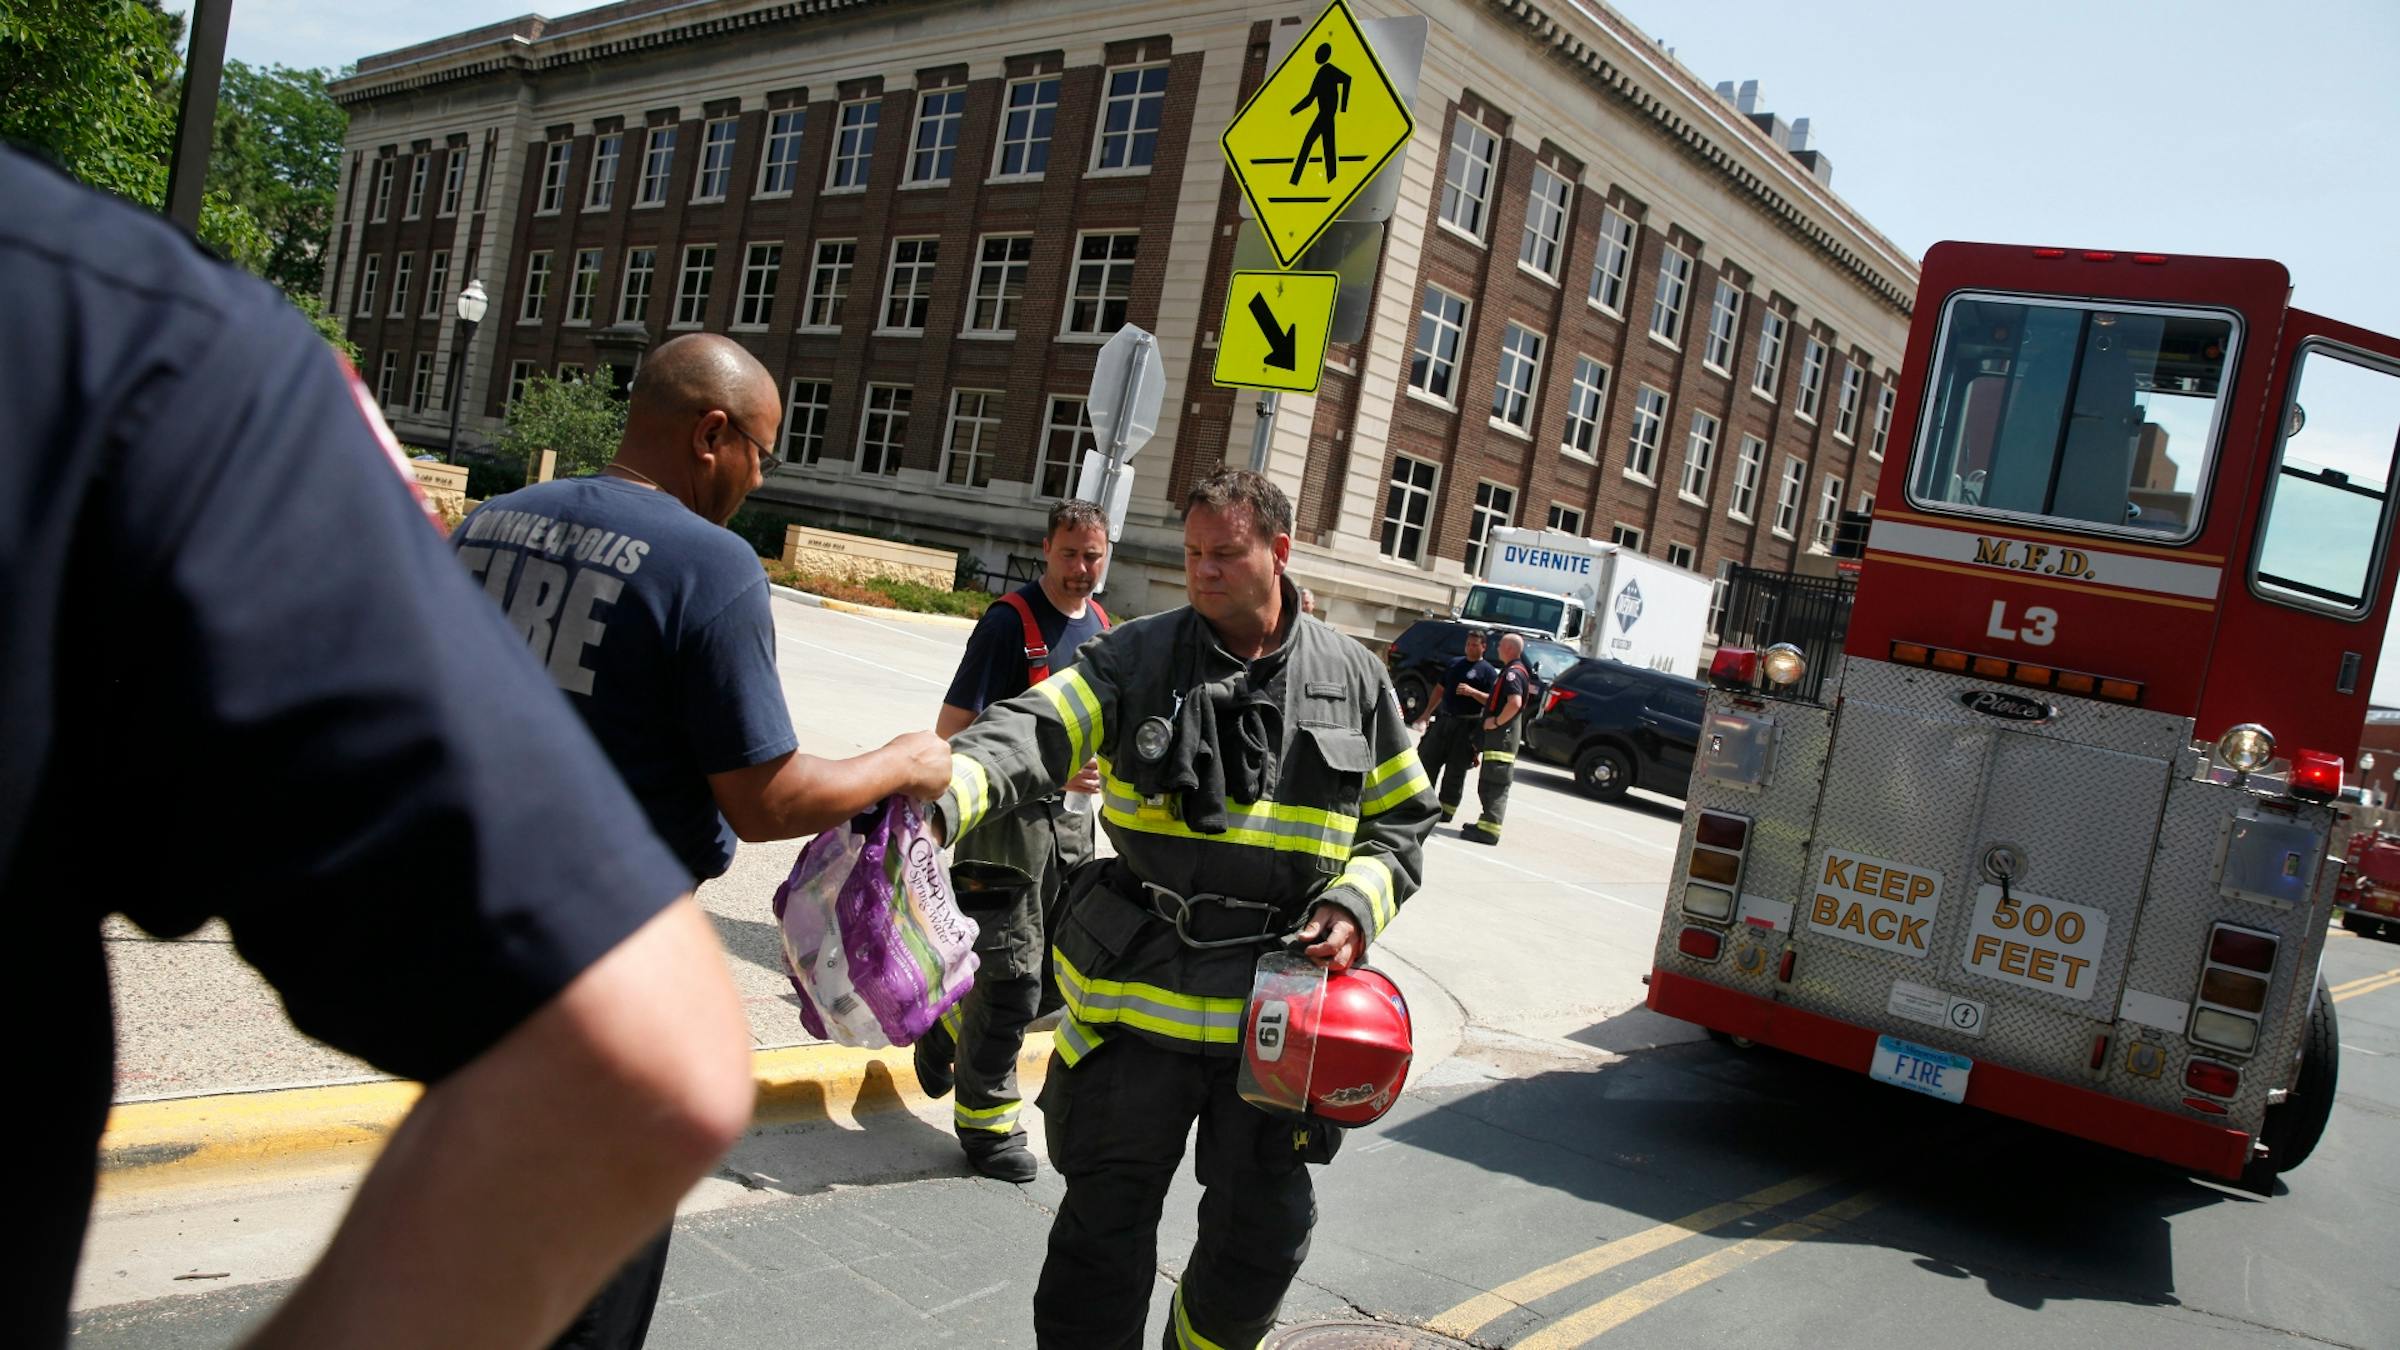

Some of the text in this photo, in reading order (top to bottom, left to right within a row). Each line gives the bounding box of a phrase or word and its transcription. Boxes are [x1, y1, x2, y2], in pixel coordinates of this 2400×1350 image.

[465, 510, 650, 574] MINNEAPOLIS
[1504, 545, 1591, 575] OVERNITE
[1972, 536, 2096, 580] M.F.D.
[456, 545, 625, 696] RE
[1986, 599, 2059, 646] L3
[1970, 692, 2040, 719] Pierce
[1823, 855, 1935, 905] KEEP
[908, 869, 951, 945] Spring Water
[1811, 893, 1929, 949] BACK
[1991, 898, 2086, 945] 500
[1971, 934, 2091, 989] FEET
[1258, 1012, 1282, 1048] 19
[1895, 1053, 1947, 1088] FIRE
